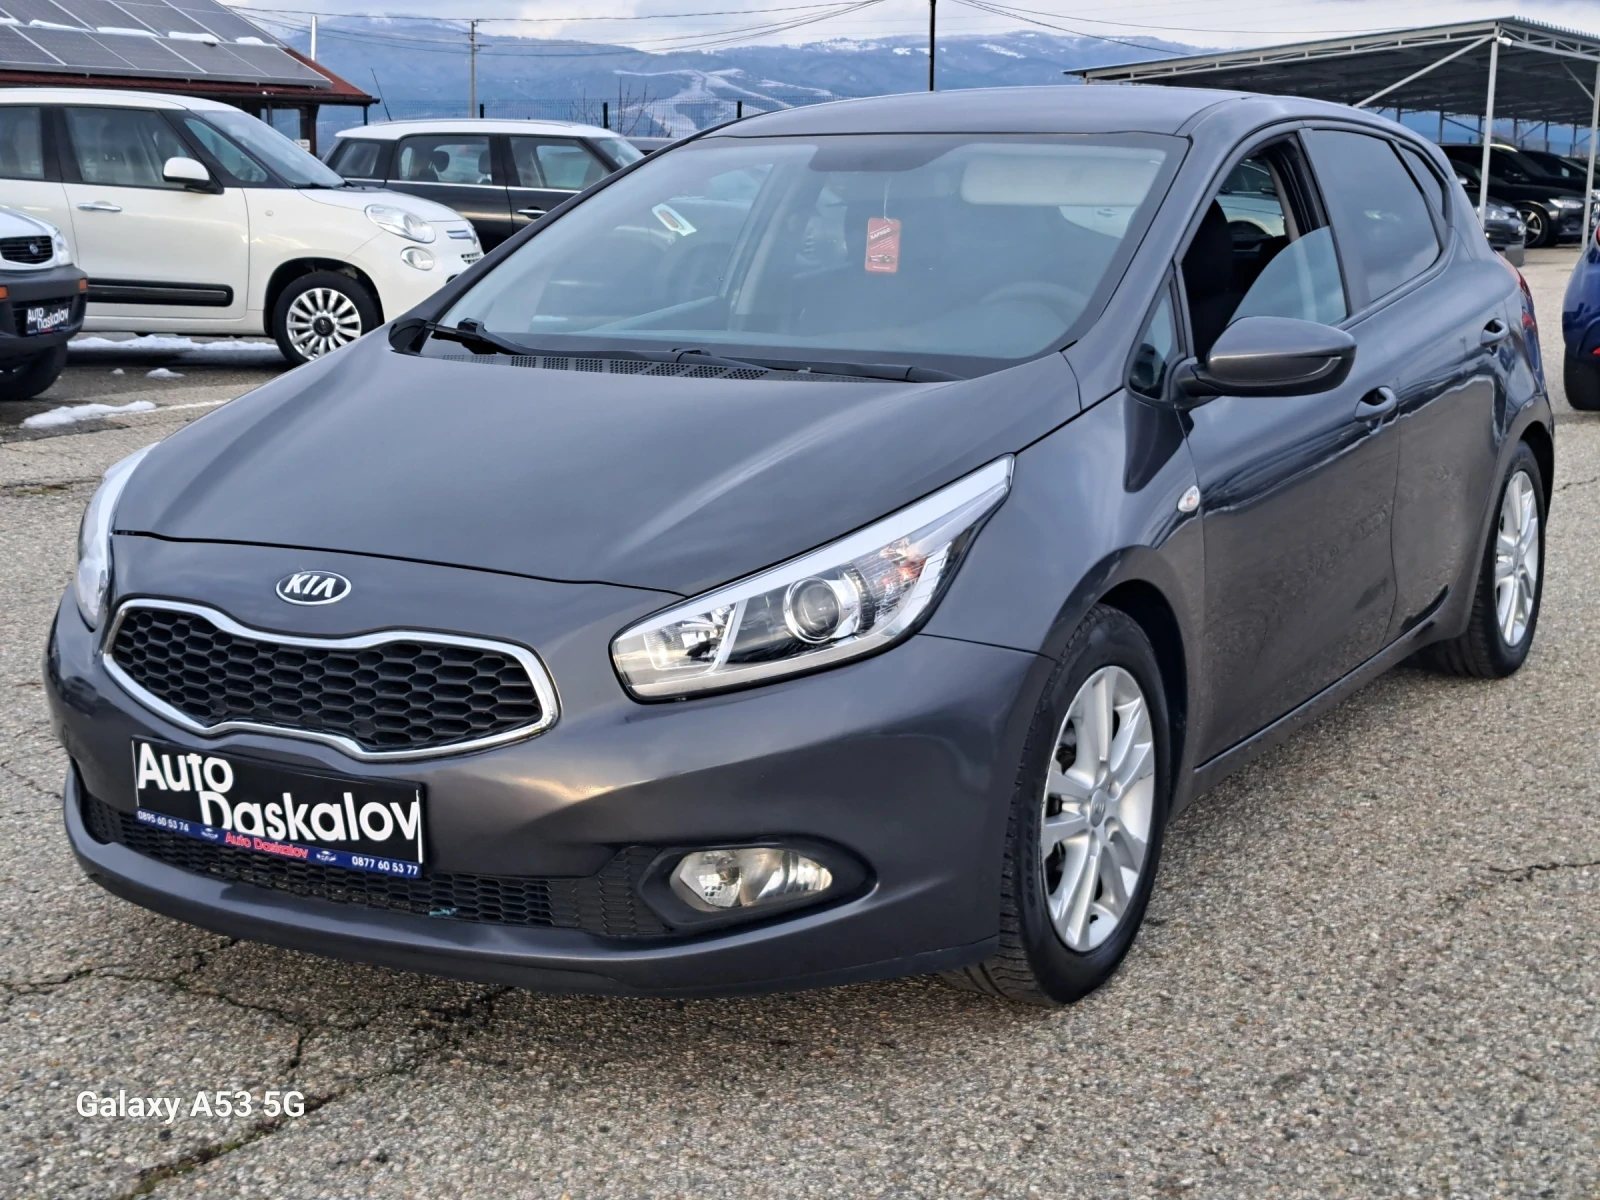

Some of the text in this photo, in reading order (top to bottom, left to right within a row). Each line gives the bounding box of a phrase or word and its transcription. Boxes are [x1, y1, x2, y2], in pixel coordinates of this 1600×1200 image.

[284, 574, 337, 598] KIA
[137, 742, 234, 793] Auto
[137, 810, 190, 832] 0895 60 53 74
[199, 790, 419, 841] Daskalov
[226, 831, 251, 848] Auto
[254, 837, 309, 859] Daskalov
[351, 855, 418, 875] 0877 60 53 77
